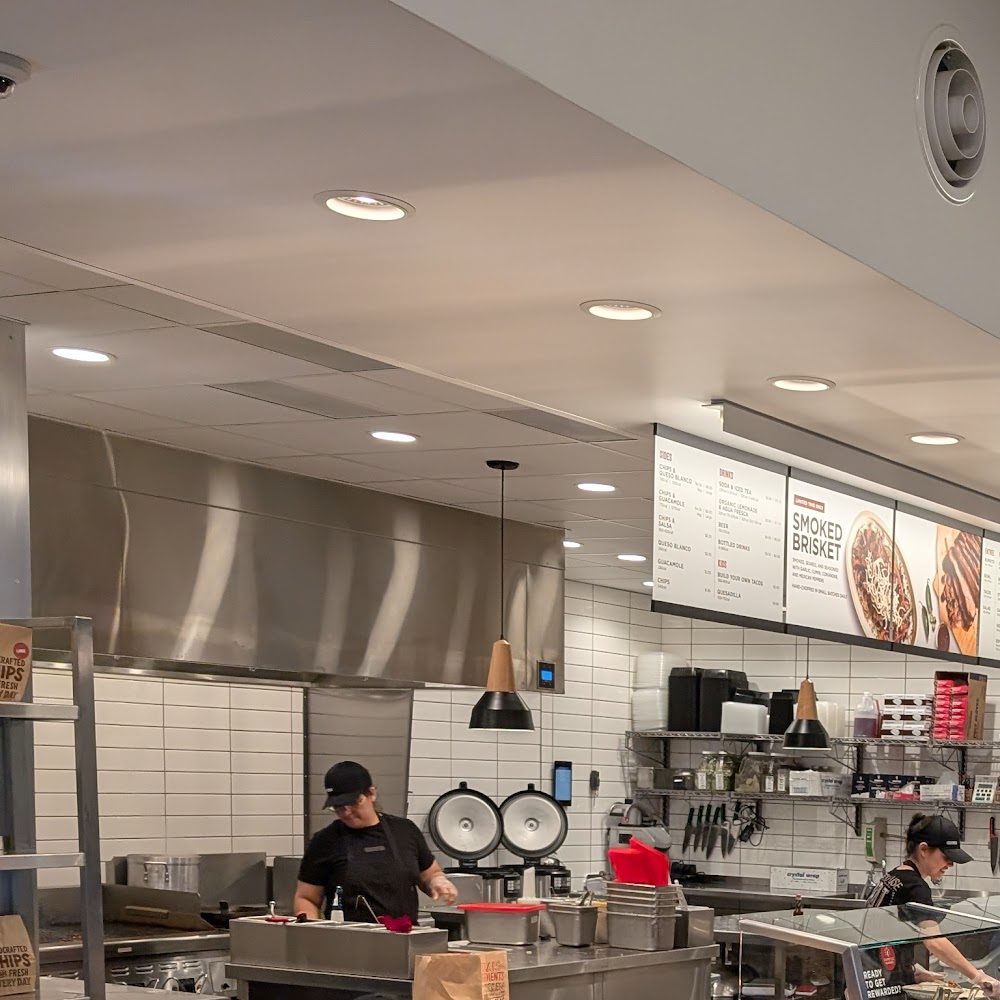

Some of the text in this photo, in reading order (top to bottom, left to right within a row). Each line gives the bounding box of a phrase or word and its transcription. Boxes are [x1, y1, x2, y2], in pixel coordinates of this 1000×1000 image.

[658, 463, 672, 473] CHIPS
[658, 470, 674, 480] QUESO
[674, 474, 693, 485] BLANCO
[658, 488, 672, 498] CHIPS
[658, 495, 686, 508] GUACAMOLE
[658, 514, 672, 523] CHIPS
[658, 520, 673, 529] SALSA
[792, 511, 843, 542] SMOKED
[657, 539, 692, 552] QUESO BLANCO
[717, 538, 736, 549] BOTTLED
[792, 532, 842, 561] BRISKET
[657, 558, 685, 570] GUACAMOLE
[657, 577, 671, 585] CHIPS
[717, 571, 730, 580] BUILD
[729, 574, 741, 582] YOUR
[751, 578, 764, 587] TACOS
[716, 588, 742, 599] QUESADILLA
[786, 871, 806, 879] crystal
[8, 968, 28, 977] FRESH
[862, 968, 882, 980] READY
[16, 977, 31, 987] DAY
[865, 978, 886, 989] TO GET
[867, 984, 902, 998] REWARDED?
